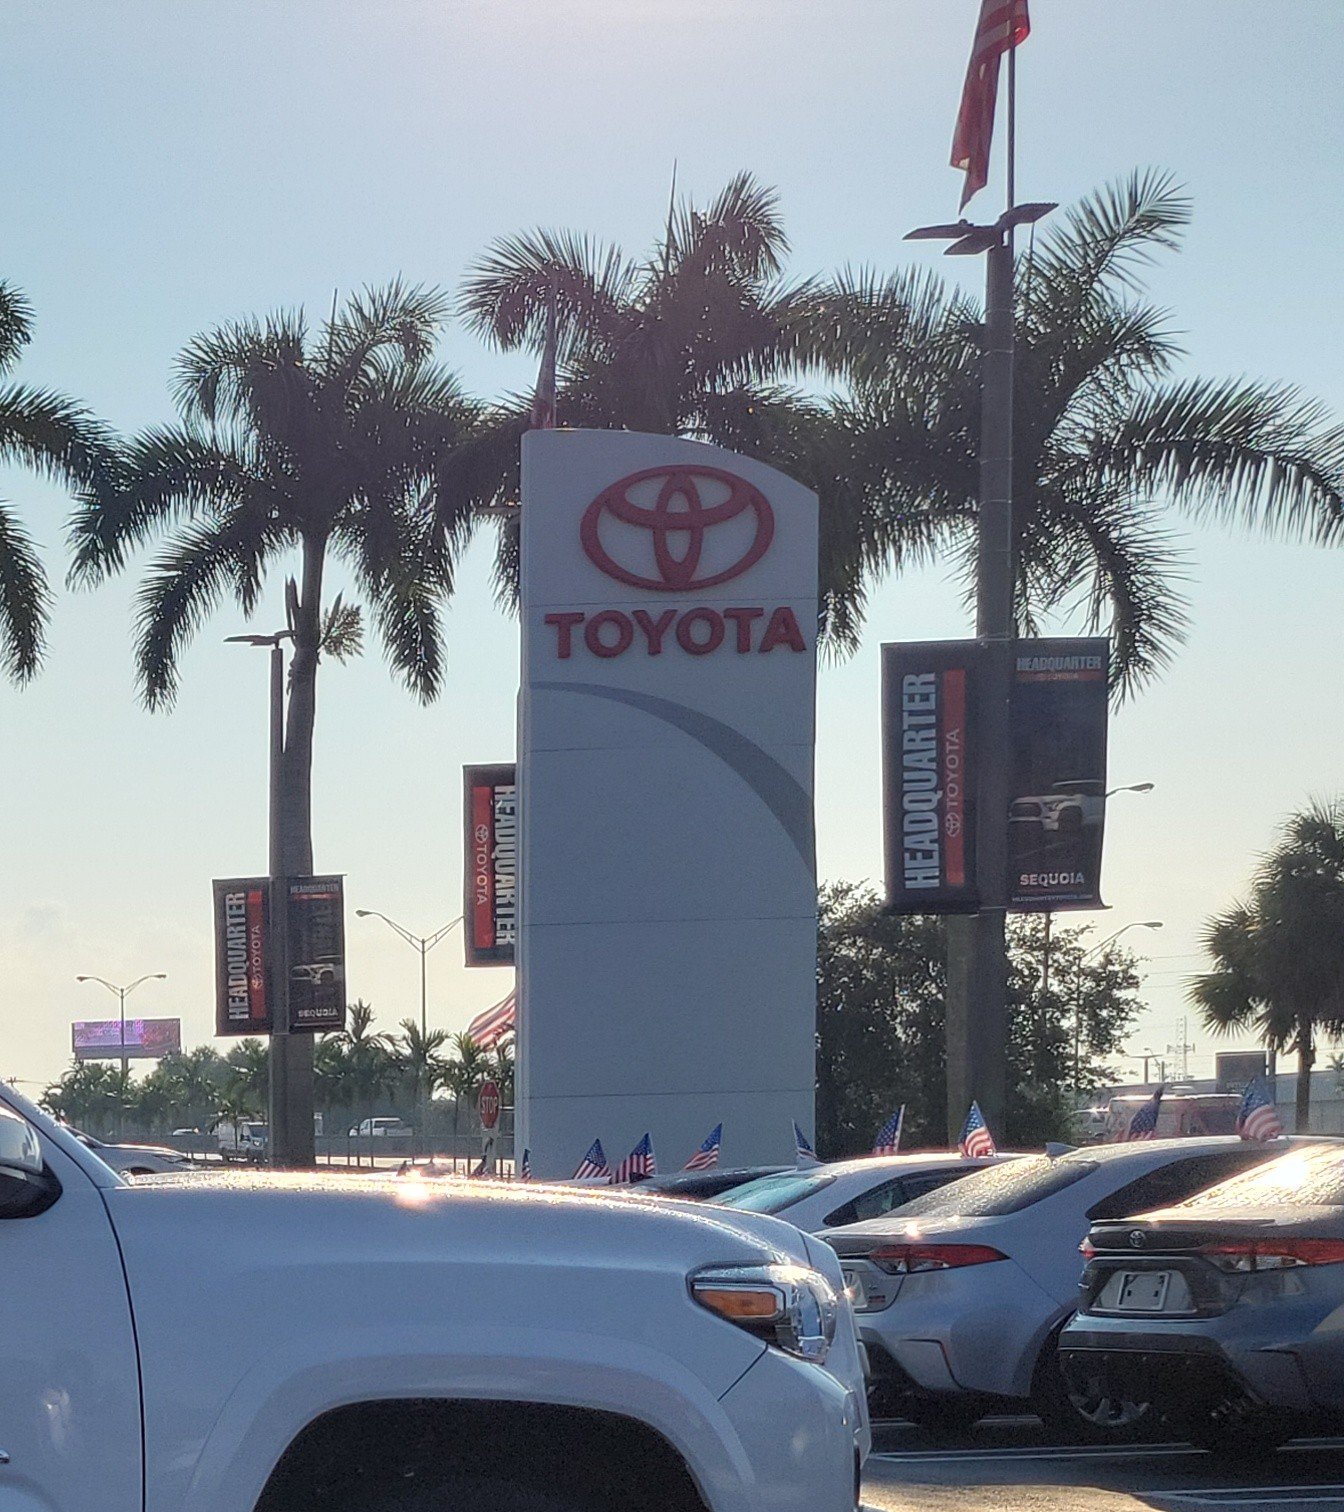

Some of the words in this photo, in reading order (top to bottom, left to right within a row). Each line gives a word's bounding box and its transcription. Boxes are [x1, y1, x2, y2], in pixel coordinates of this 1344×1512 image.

[544, 606, 807, 659] TOYOTA
[1017, 655, 1101, 671] HEADQUARTER
[902, 672, 943, 889] HEADQUARTER
[946, 728, 960, 807] TOYOTA
[476, 844, 488, 905] TOYOTA
[1019, 872, 1085, 887] SEQUOIA
[226, 893, 249, 1020] HEADQUARTER
[251, 925, 261, 977] TOYOTA
[298, 1008, 339, 1018] SEQUOIA
[482, 1096, 498, 1114] STOP
